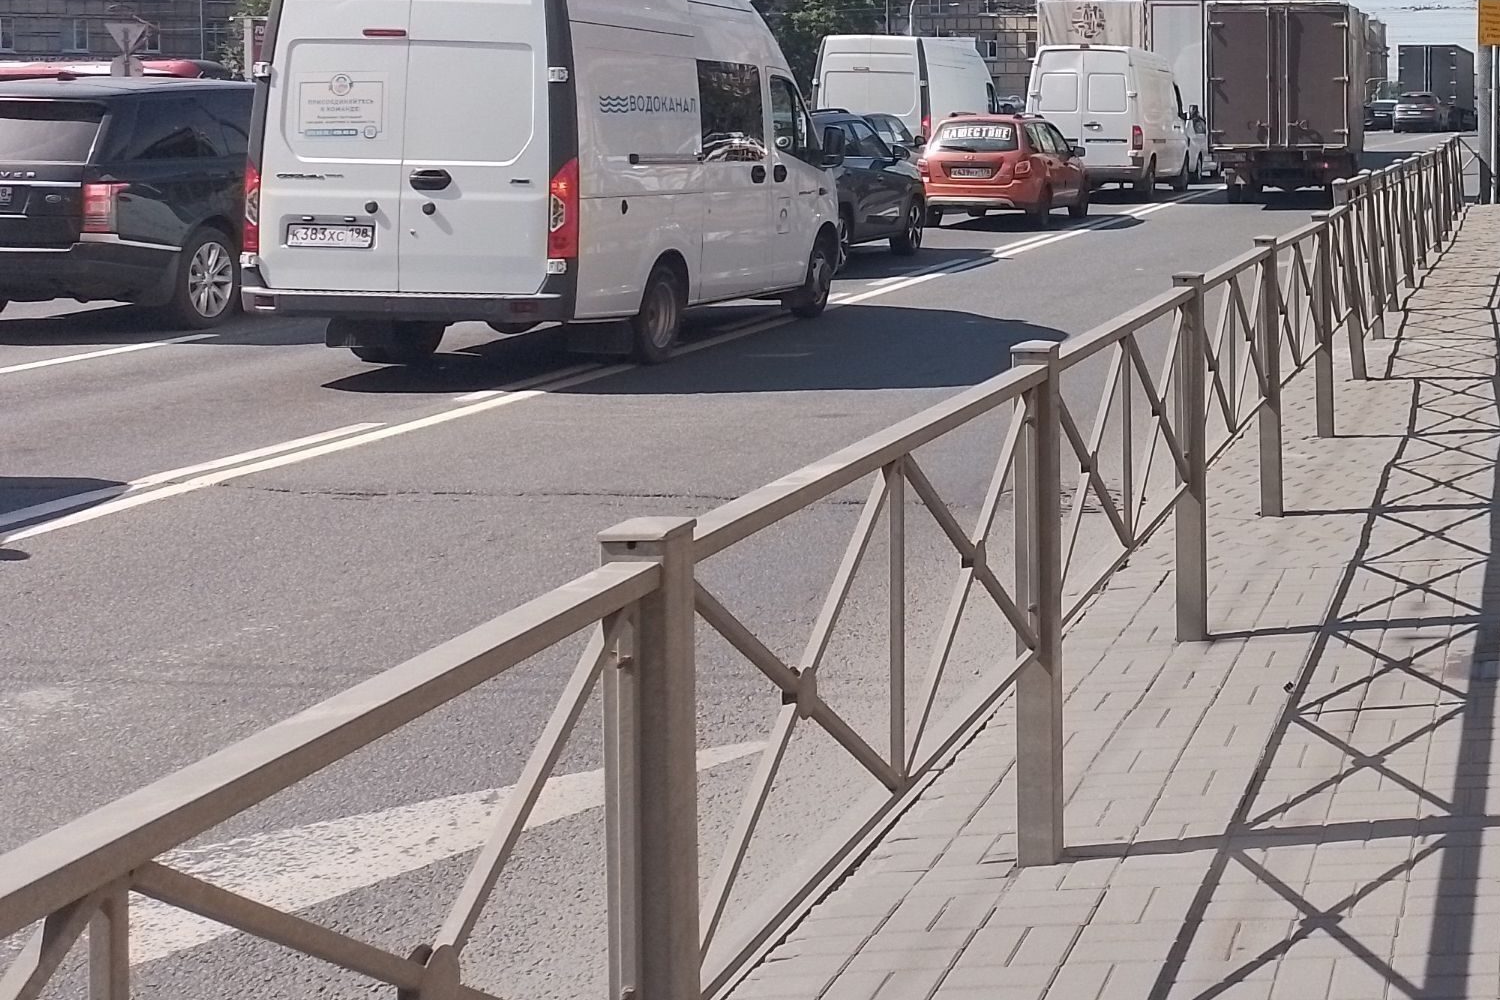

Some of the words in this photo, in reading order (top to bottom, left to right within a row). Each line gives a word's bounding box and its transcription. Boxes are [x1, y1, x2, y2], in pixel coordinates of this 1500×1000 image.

[629, 95, 697, 113] ВОДОКАНАЛ
[942, 127, 1010, 139] НАШЕСТВИЕ
[349, 228, 367, 238] 198
